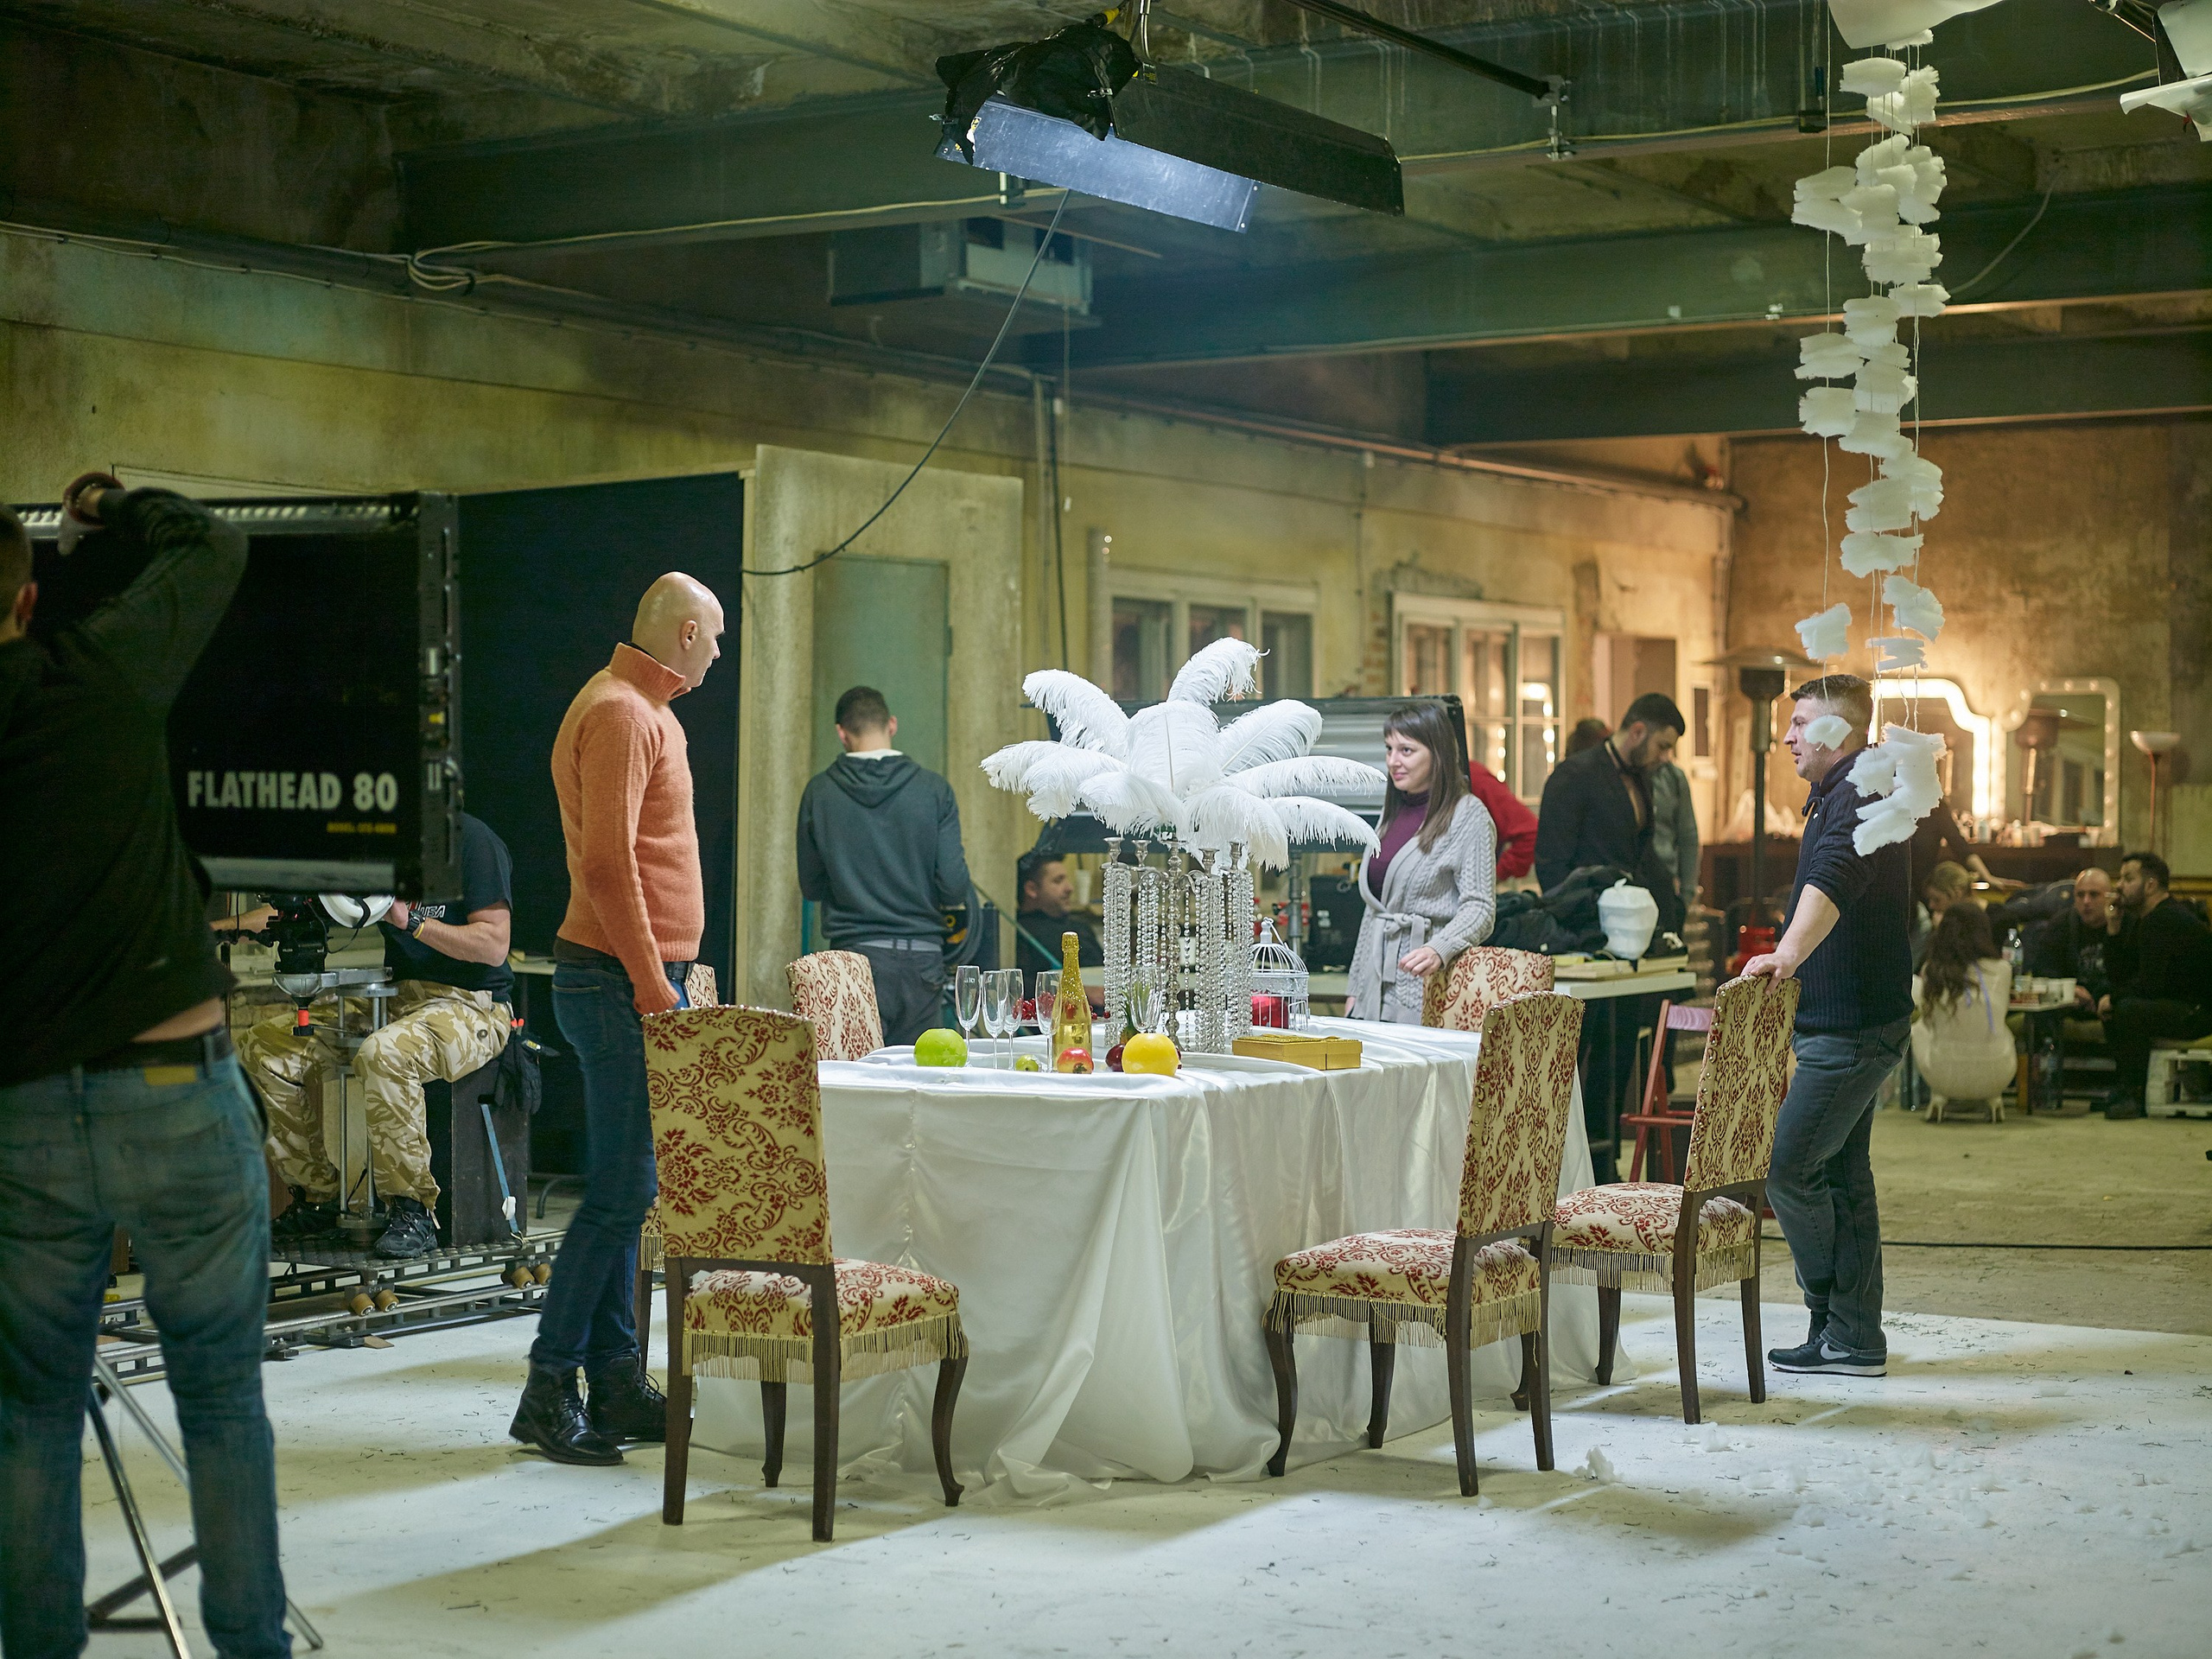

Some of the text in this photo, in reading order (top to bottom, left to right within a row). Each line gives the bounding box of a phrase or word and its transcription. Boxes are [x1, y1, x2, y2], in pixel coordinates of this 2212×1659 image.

[188, 771, 398, 811] FLATHEAD 80
[420, 905, 446, 918] USA
